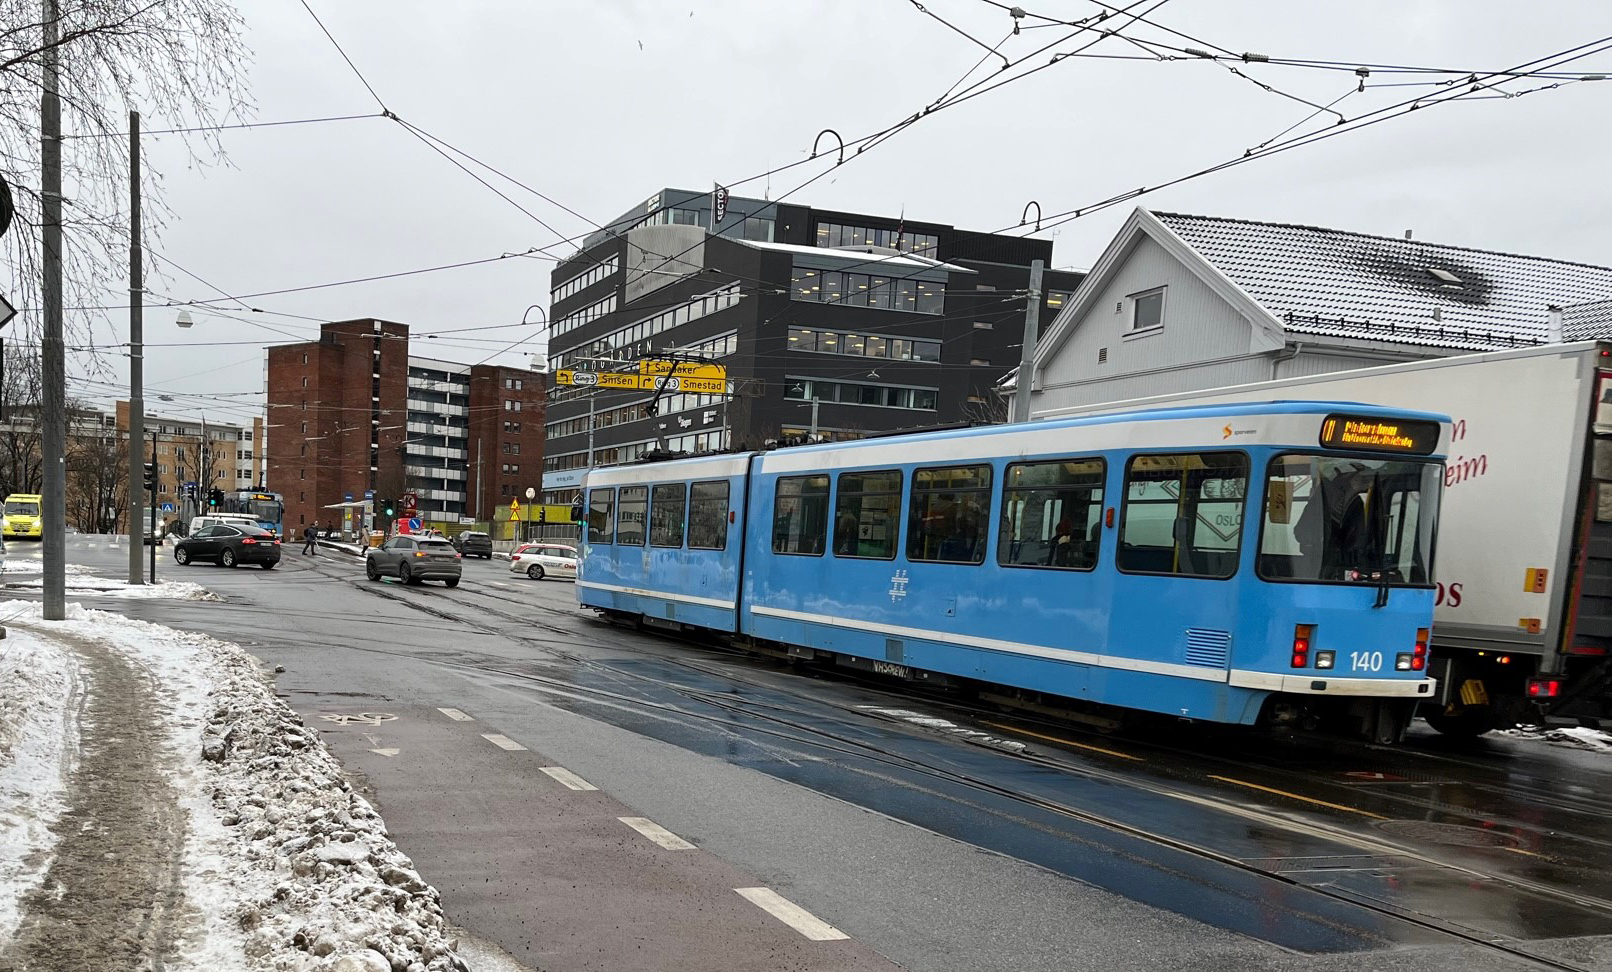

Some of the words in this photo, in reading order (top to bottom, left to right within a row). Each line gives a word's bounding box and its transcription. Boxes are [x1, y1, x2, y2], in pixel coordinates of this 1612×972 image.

[655, 362, 696, 375] Sanaker
[590, 375, 595, 383] 3
[602, 374, 633, 385] Sinsen
[657, 379, 671, 389] Rg
[672, 380, 677, 388] 3
[683, 379, 722, 391] Smestad
[1444, 454, 1487, 487] eim
[1350, 651, 1383, 671] 140
